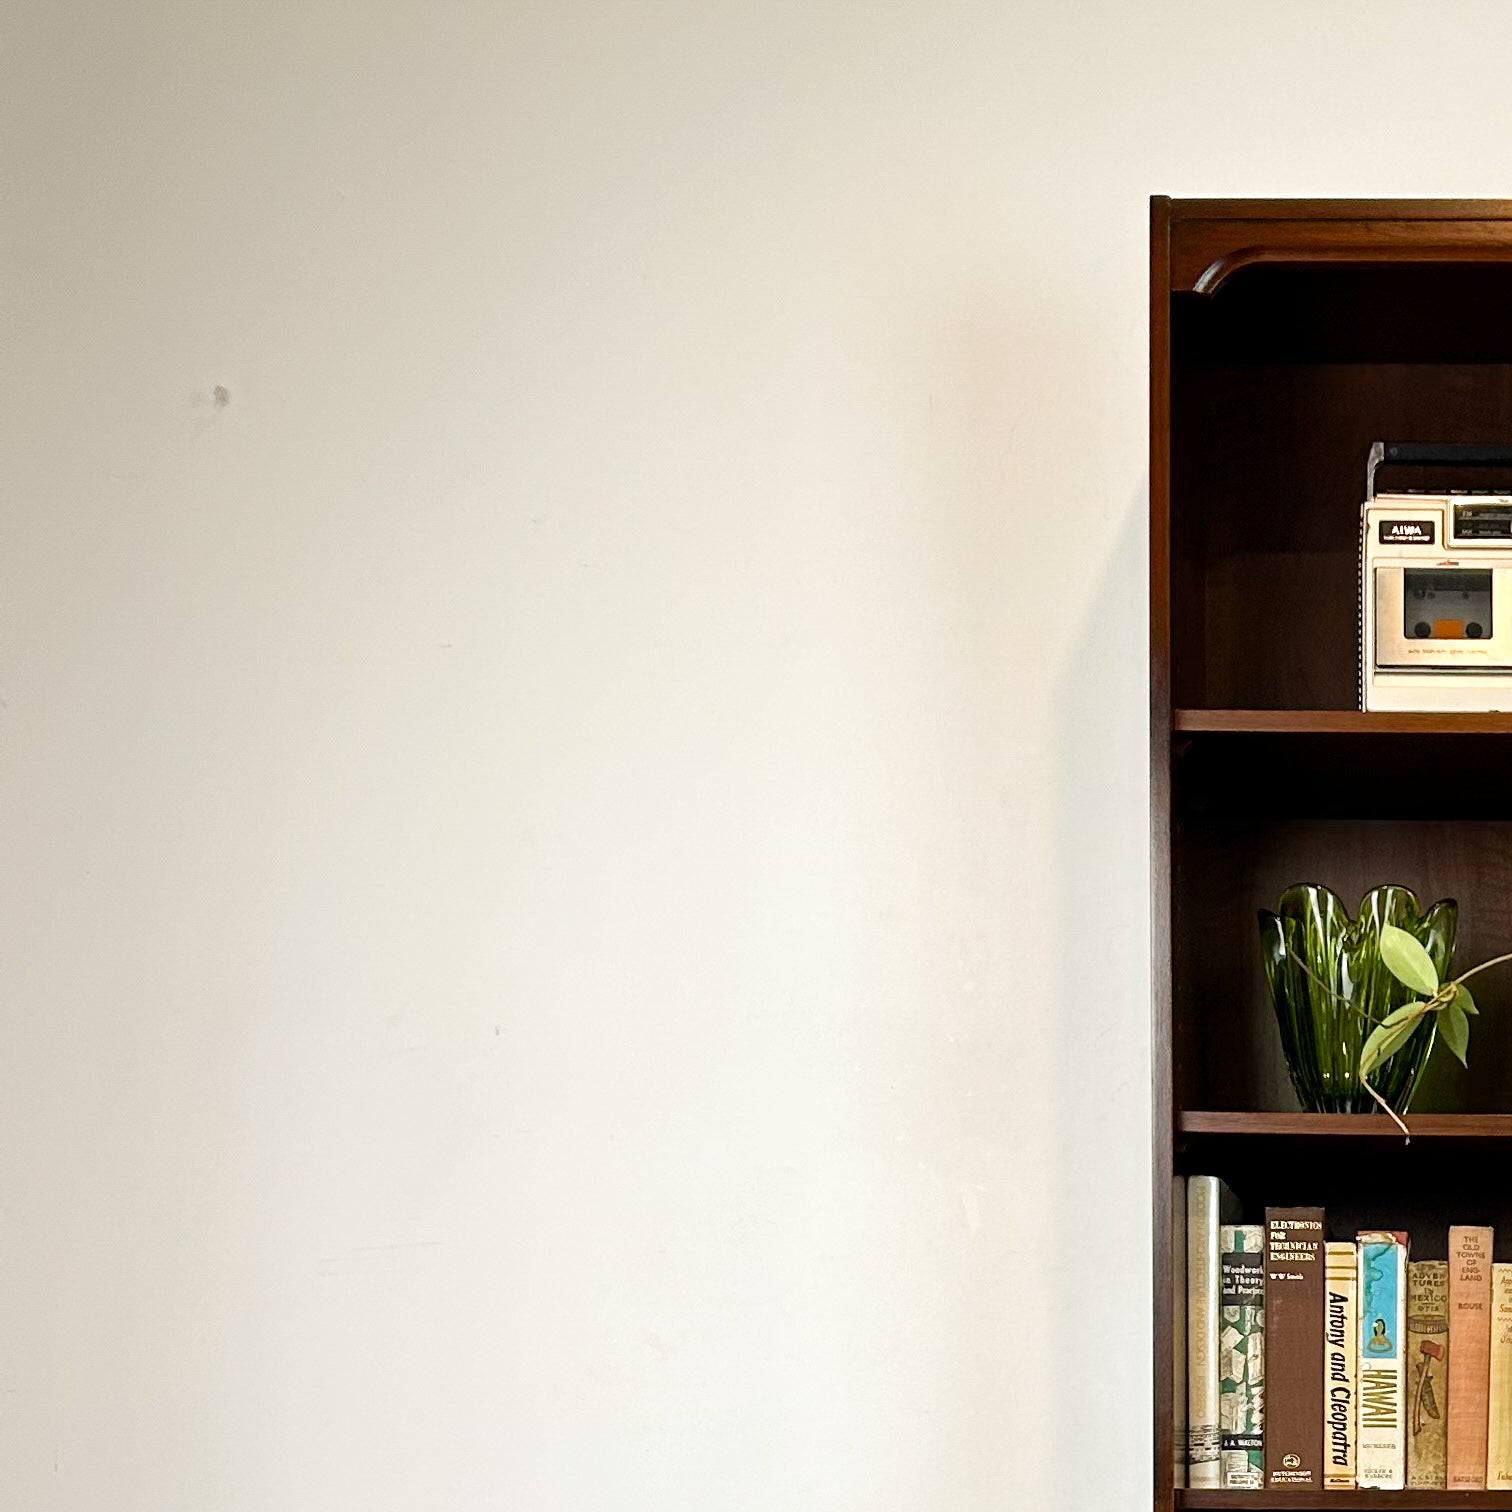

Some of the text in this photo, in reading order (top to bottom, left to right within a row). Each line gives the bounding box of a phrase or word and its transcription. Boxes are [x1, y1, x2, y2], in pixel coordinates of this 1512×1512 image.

[1391, 524, 1422, 535] AIWA
[1270, 1220, 1323, 1230] ELECTRONICS
[1270, 1231, 1287, 1240] FOR
[1463, 1235, 1479, 1244] THE
[1269, 1241, 1319, 1251] TECHNICIAN
[1462, 1243, 1480, 1251] OLD
[1270, 1252, 1316, 1261] ENGINEERS
[1456, 1251, 1486, 1259] TOWNS
[1197, 1232, 1206, 1306] ARCHITECTURE
[1461, 1266, 1481, 1274] ENG-
[1234, 1274, 1264, 1287] Theory
[1222, 1284, 1236, 1295] and
[1409, 1294, 1448, 1302] MEXICO
[1457, 1302, 1483, 1310] ROUSE
[1197, 1306, 1206, 1329] AND
[1325, 1291, 1349, 1348] Antony
[1197, 1330, 1206, 1366] DESIGN
[1330, 1352, 1350, 1383] and
[1362, 1369, 1398, 1429] HAWAII
[1327, 1386, 1351, 1467] Cleopatra
